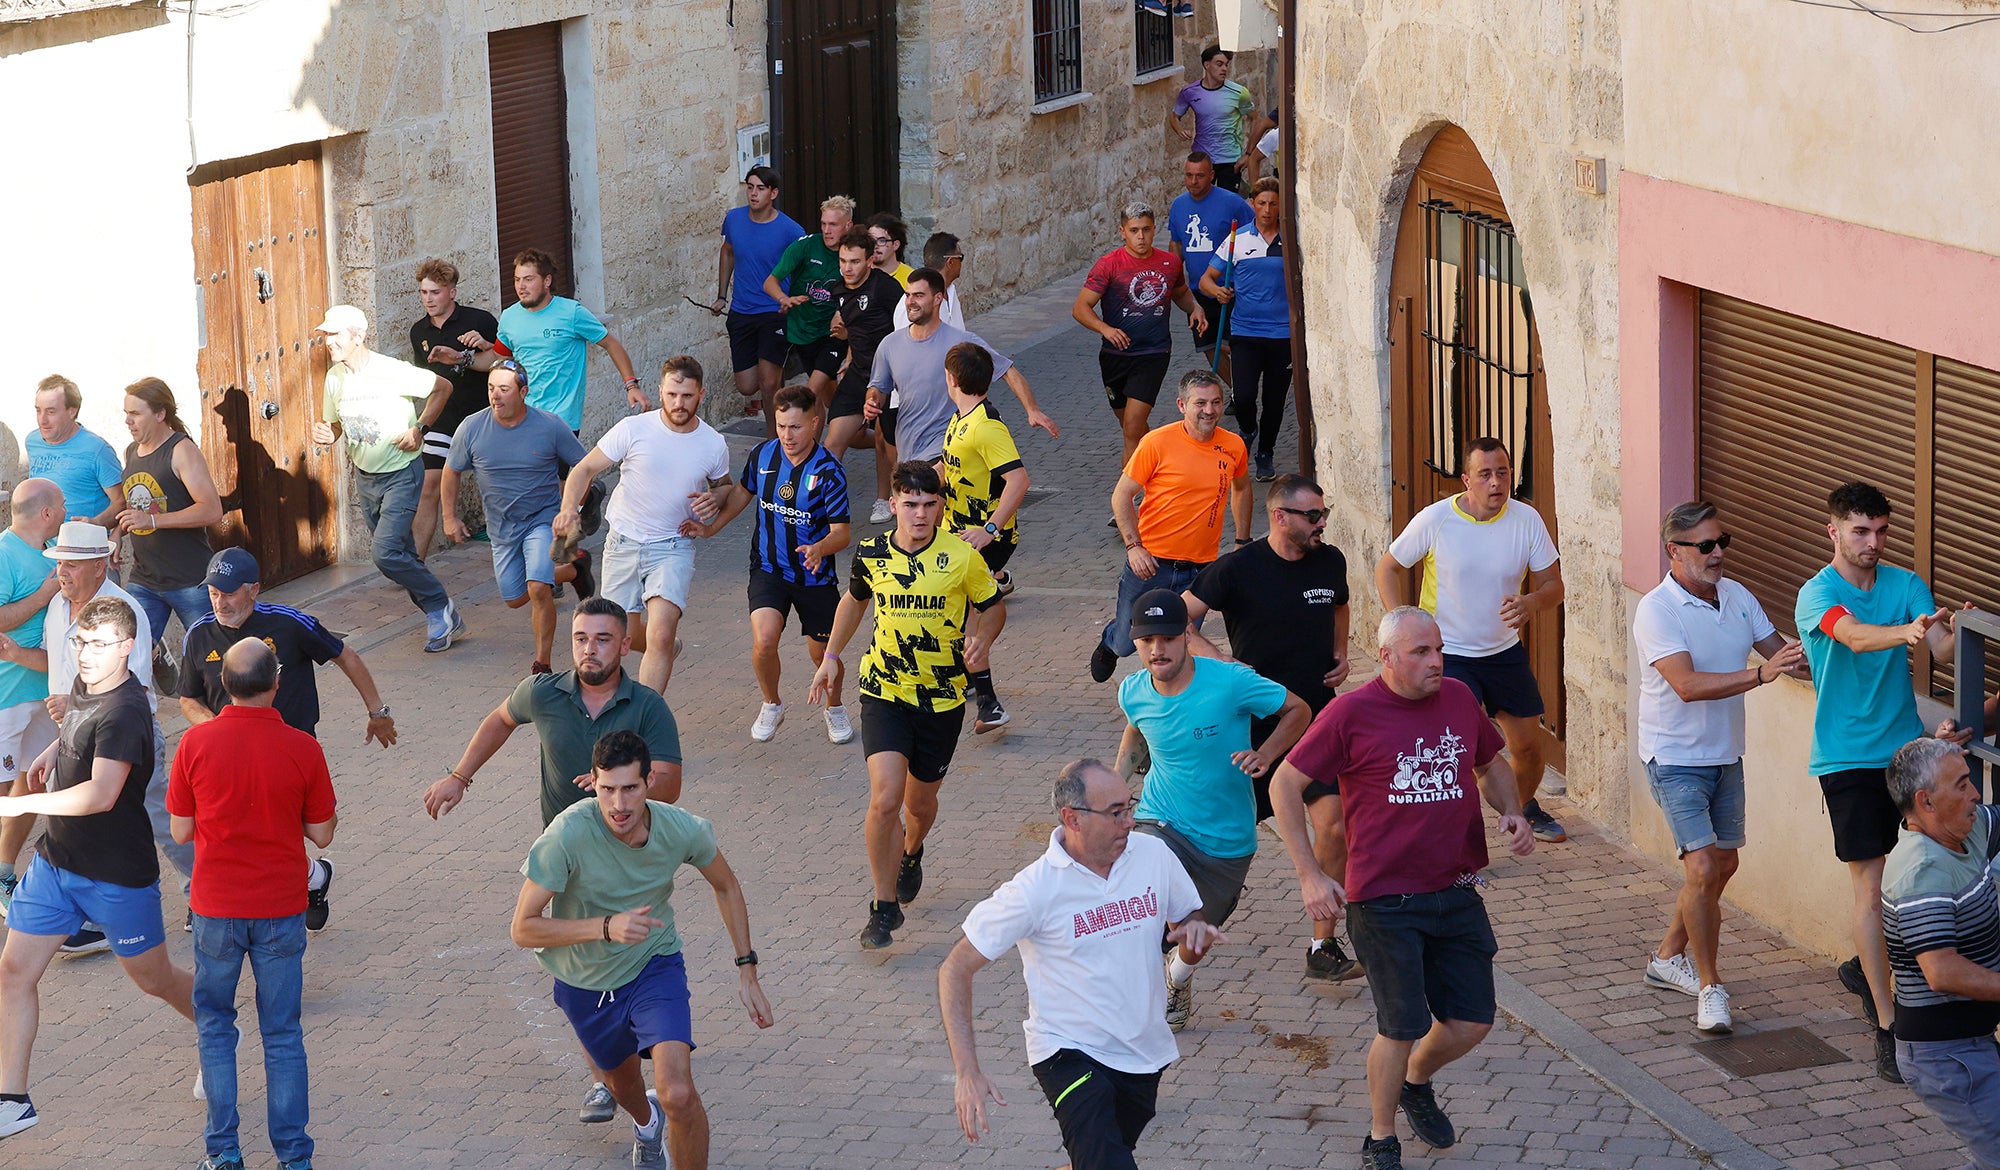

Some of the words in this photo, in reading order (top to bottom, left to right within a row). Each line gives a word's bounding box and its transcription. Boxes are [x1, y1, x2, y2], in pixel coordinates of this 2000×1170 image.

[759, 497, 812, 519] betsson
[889, 594, 947, 610] IMPALAG
[1388, 789, 1464, 804] RURALIZATE
[1073, 886, 1158, 939] AMBIGÚ
